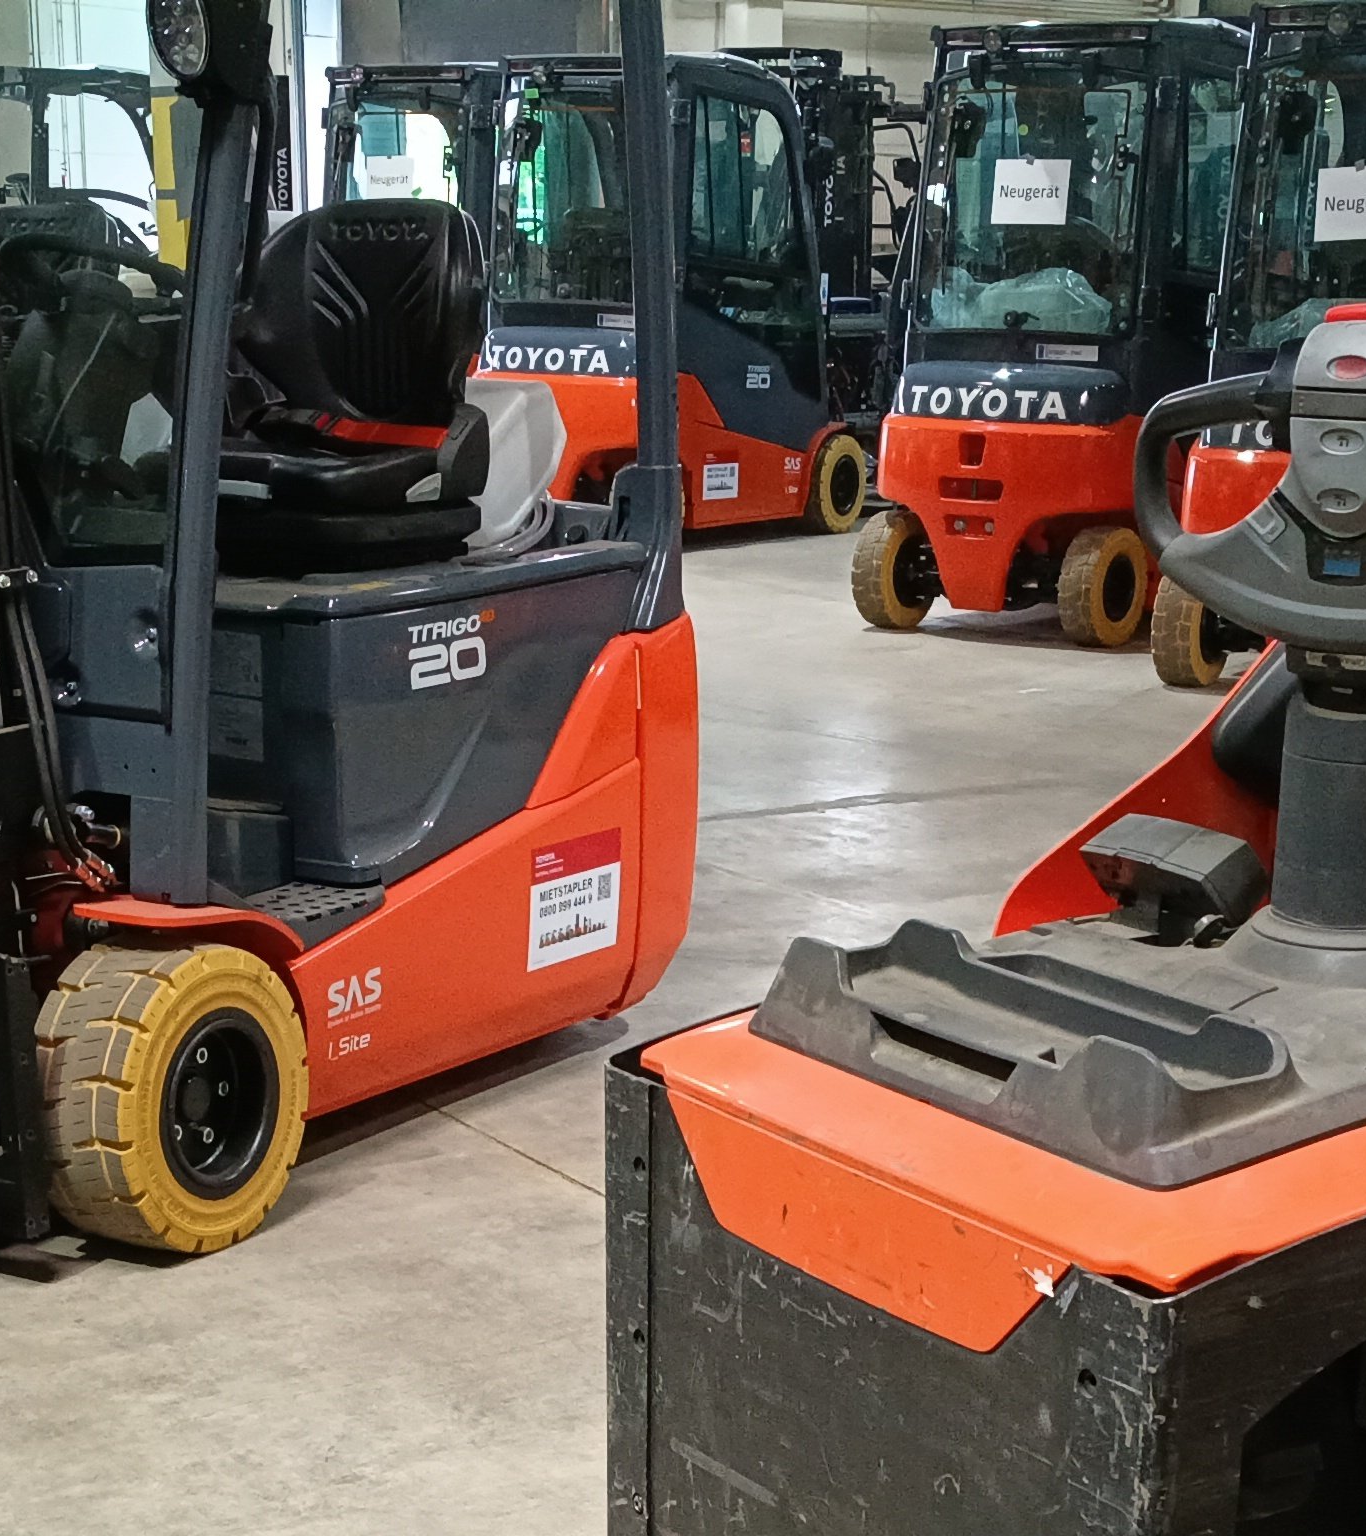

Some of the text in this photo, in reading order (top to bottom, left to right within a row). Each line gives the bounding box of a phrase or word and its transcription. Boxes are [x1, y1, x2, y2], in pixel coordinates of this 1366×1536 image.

[276, 147, 289, 210] TOYOTA
[370, 174, 409, 186] Neugerät
[999, 184, 1060, 202] Neugerät
[491, 345, 610, 373] TOYOTA
[746, 373, 771, 389] 20
[911, 385, 1067, 420] TOYOTA
[784, 457, 801, 470] SAS
[408, 636, 487, 690] 20
[539, 877, 593, 902] MIETSTAPLER
[327, 966, 382, 1018] SAS
